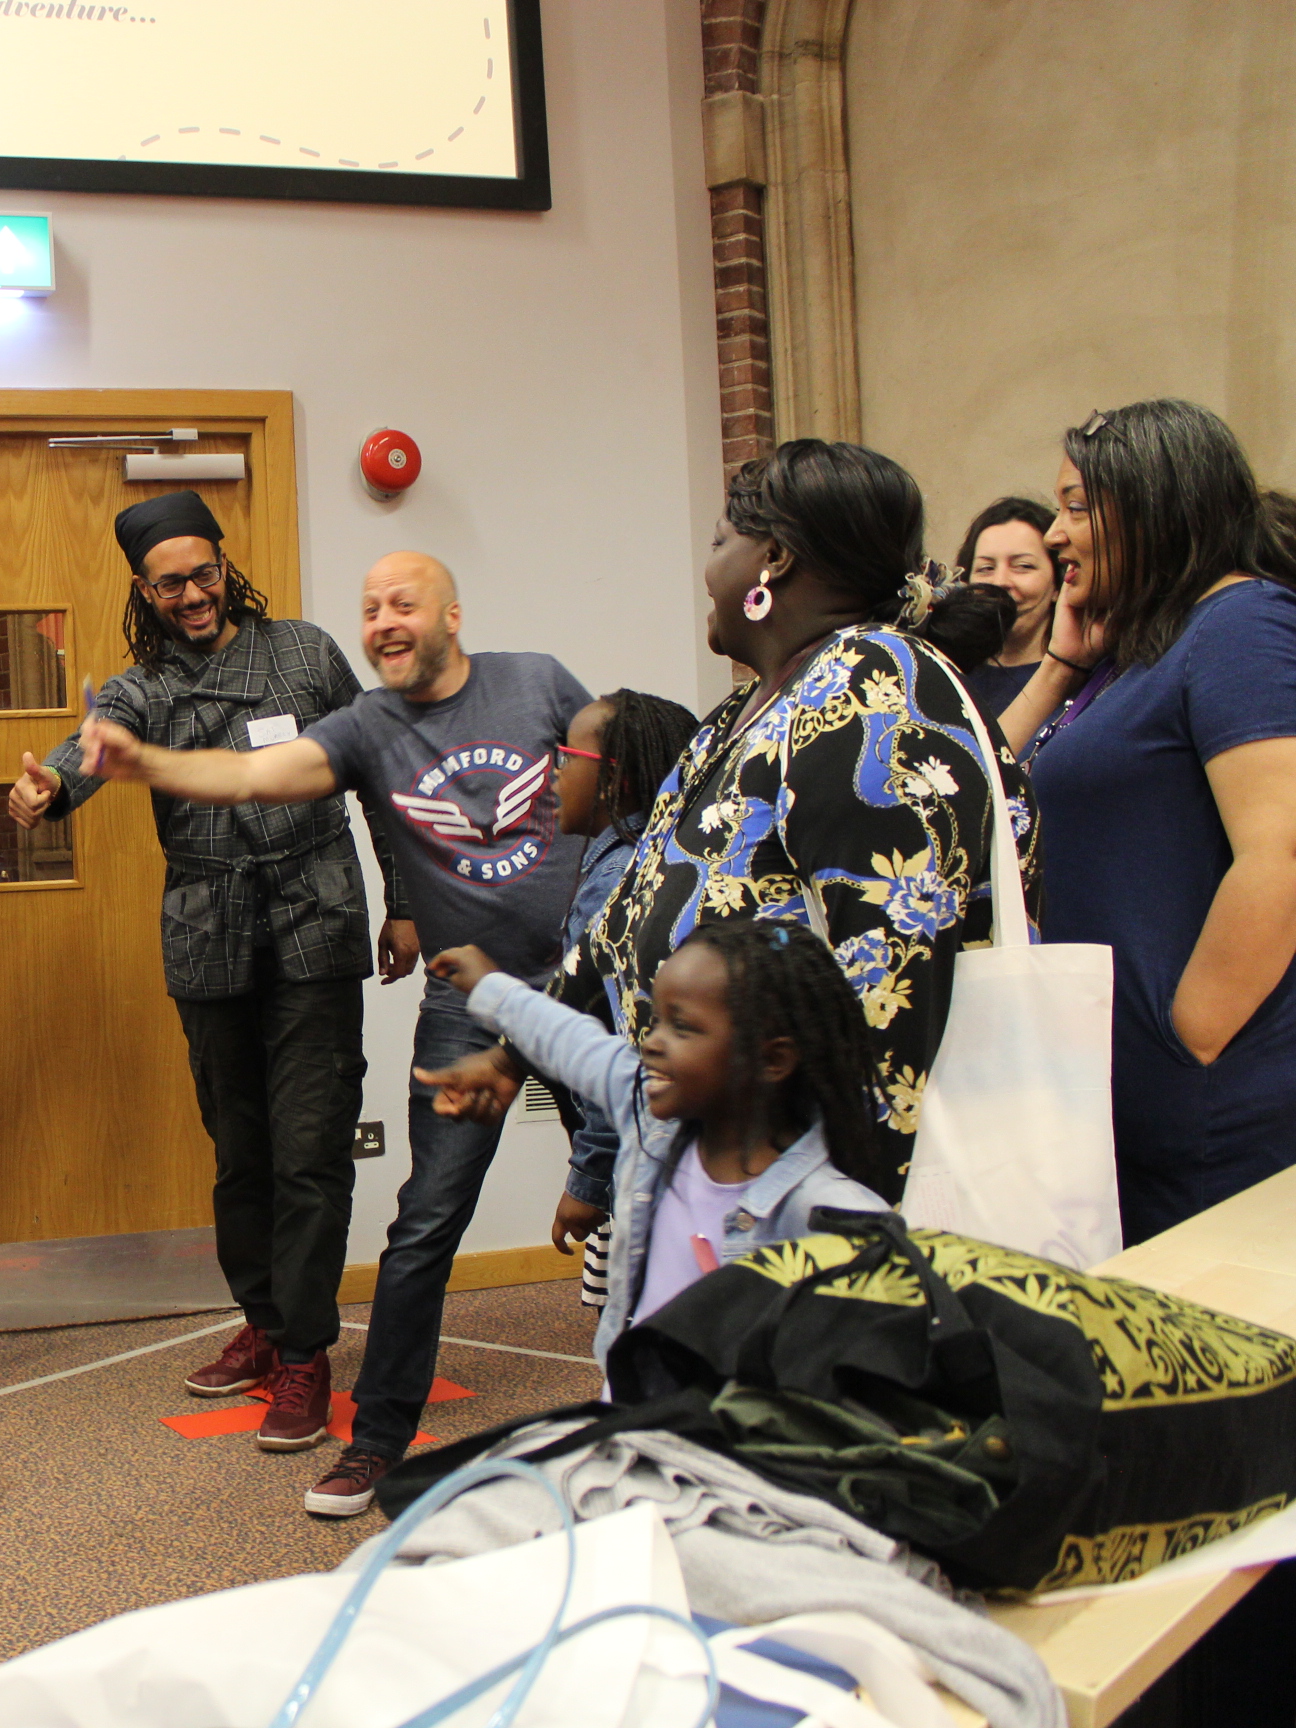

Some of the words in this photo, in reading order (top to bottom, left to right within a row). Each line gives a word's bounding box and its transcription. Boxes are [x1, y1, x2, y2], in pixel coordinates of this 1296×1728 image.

[417, 747, 524, 797] MUMFORD
[457, 859, 473, 876] &
[481, 842, 538, 880] SONS
